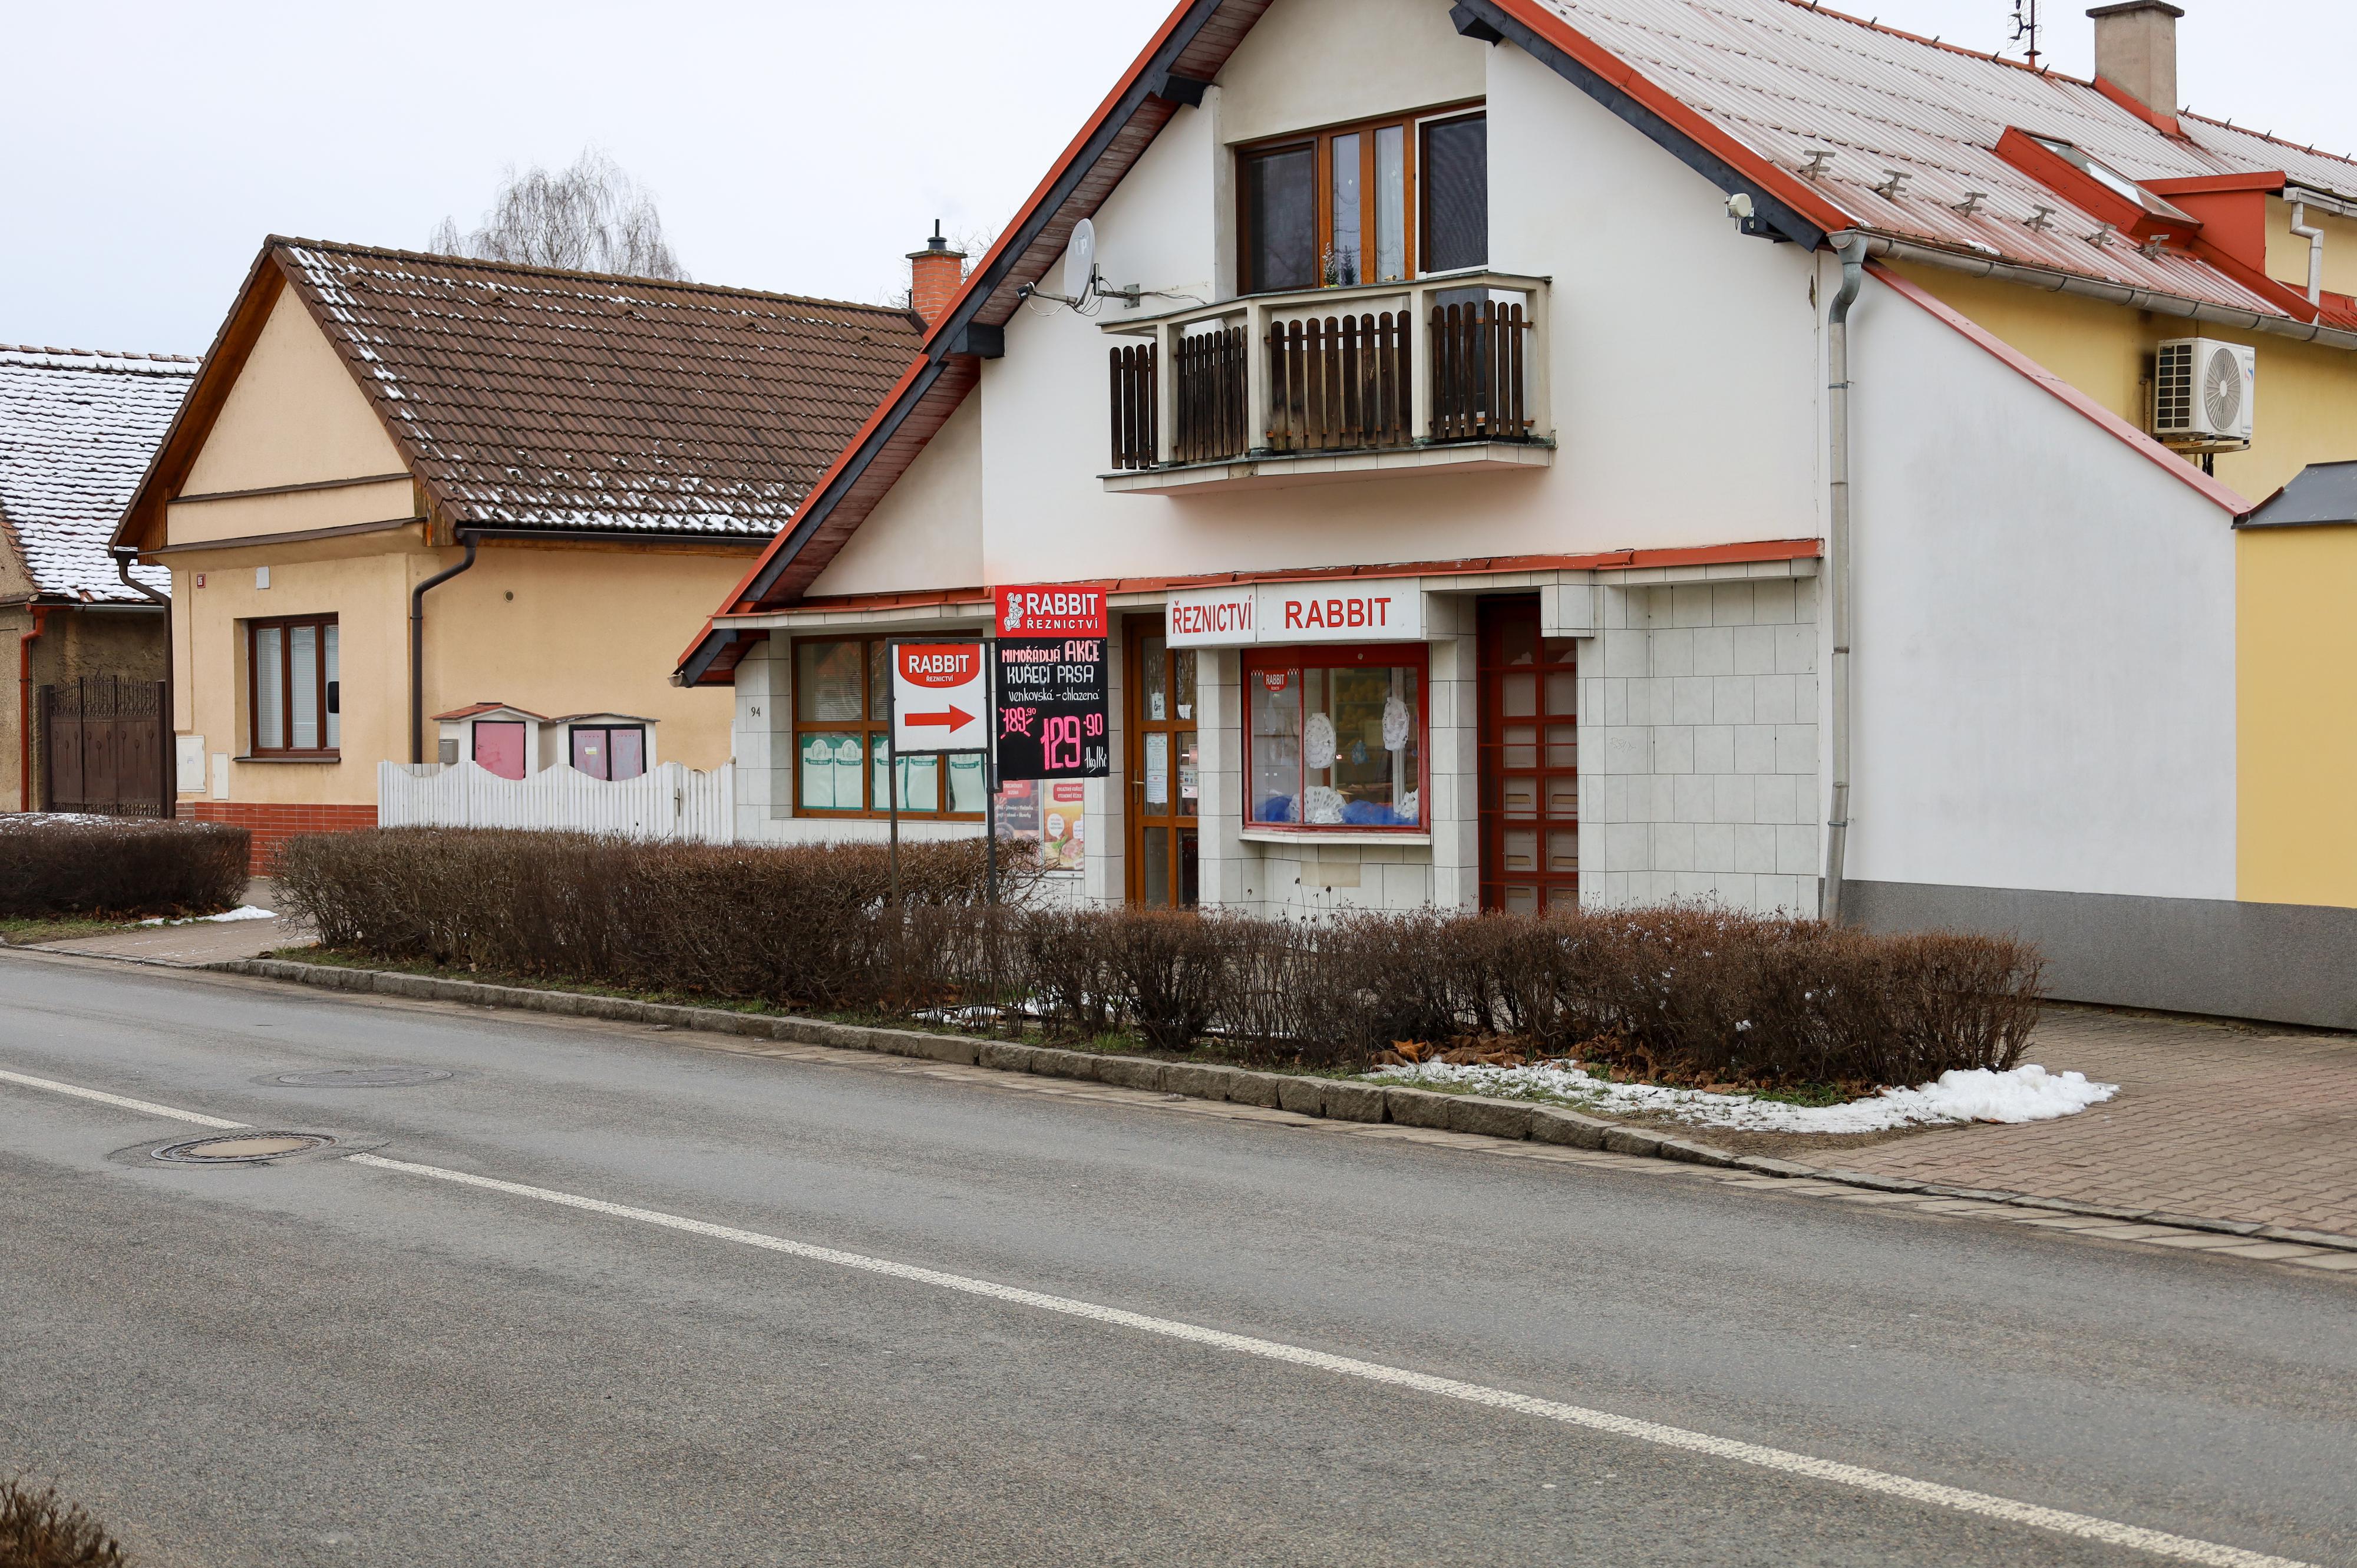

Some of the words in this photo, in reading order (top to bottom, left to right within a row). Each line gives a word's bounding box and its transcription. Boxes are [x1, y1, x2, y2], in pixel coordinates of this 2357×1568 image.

[1026, 593, 1098, 615] RABBIT
[1027, 618, 1098, 629] ŘEZNICTVÍ
[1173, 595, 1252, 634] ŘEZNICTVÍ
[1285, 598, 1391, 629] RABBIT
[1002, 645, 1061, 663] MIMOŘÁDNÁ
[1065, 640, 1101, 662] AKCE
[909, 655, 969, 674] RABBIT
[1006, 663, 1055, 684] KUŘECÍ
[1057, 665, 1094, 684] PRSA
[1266, 674, 1285, 685] RABBIT
[1008, 687, 1054, 702] venkovská
[1062, 686, 1100, 701] chlazená
[751, 707, 760, 717] 94
